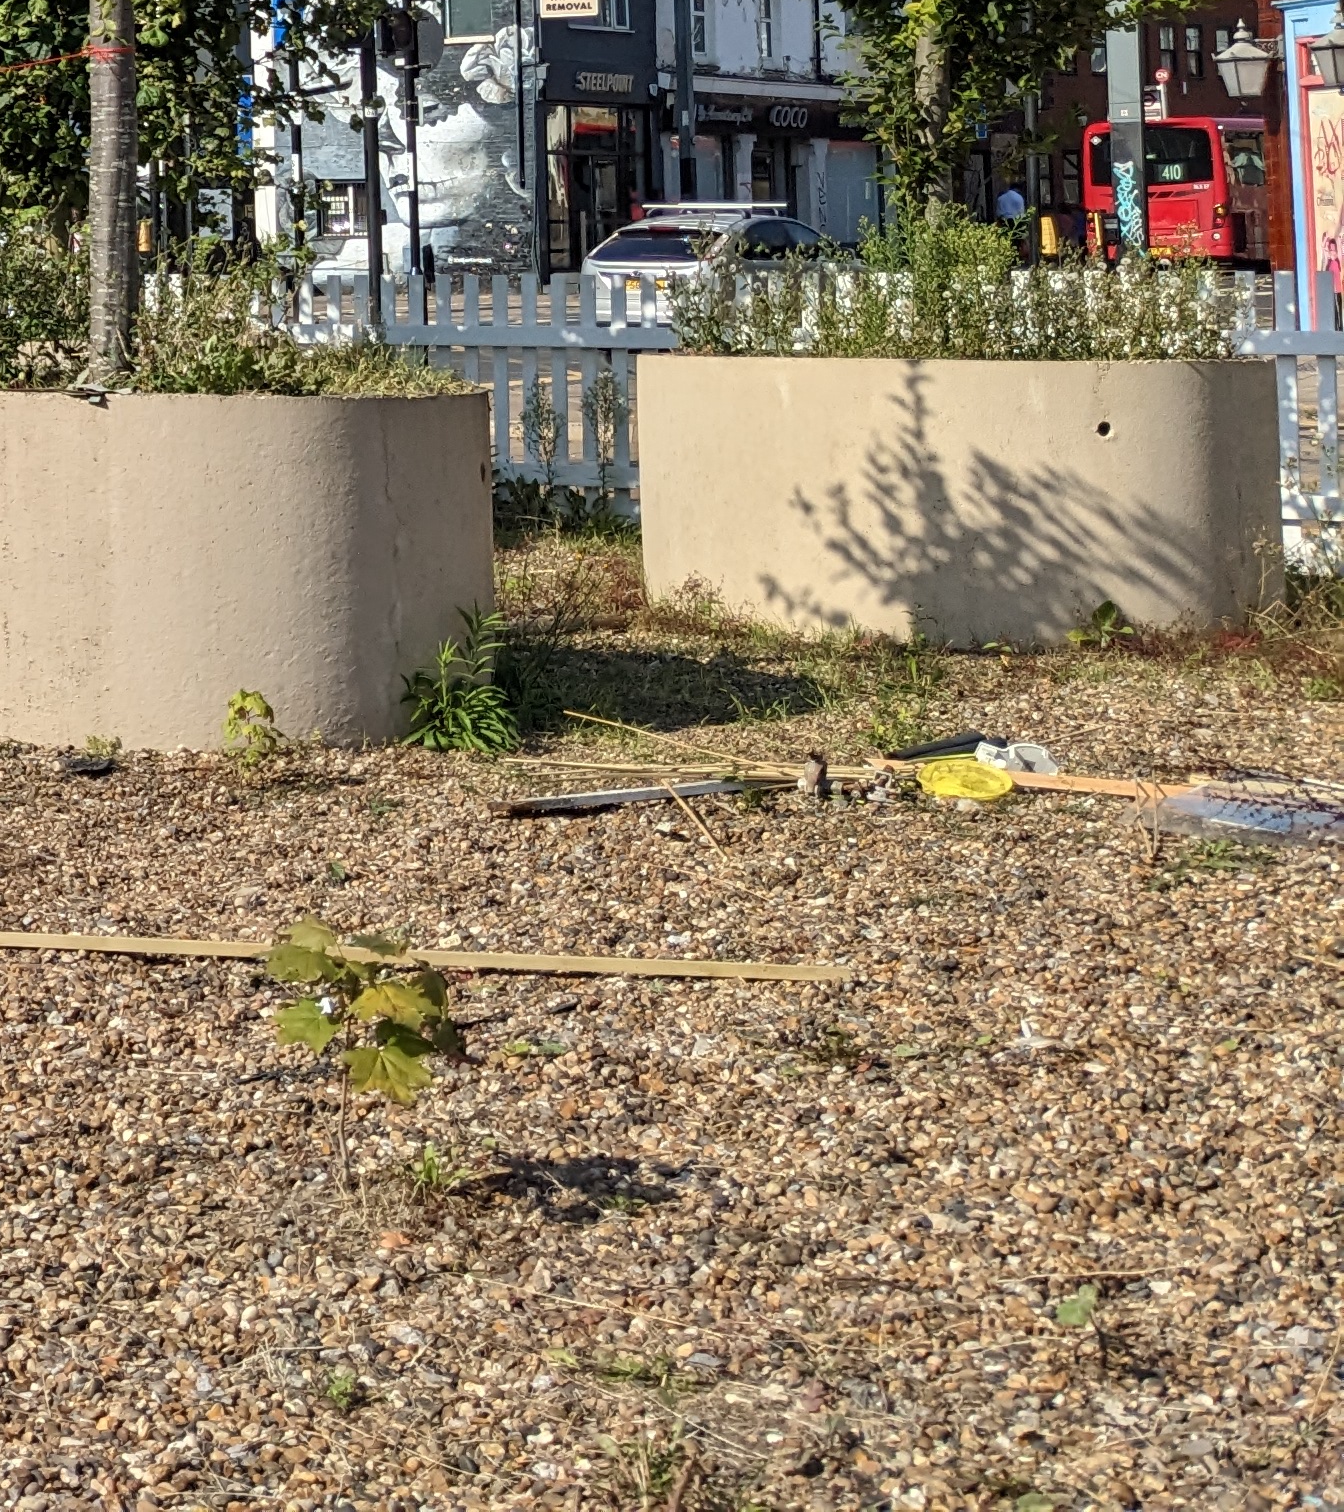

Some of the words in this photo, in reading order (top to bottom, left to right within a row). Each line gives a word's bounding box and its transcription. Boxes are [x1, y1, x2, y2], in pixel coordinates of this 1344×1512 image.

[546, 2, 592, 11] REMOVAL
[577, 72, 634, 93] STEELPOINT
[772, 105, 808, 128] COCO
[1161, 164, 1181, 180] 410
